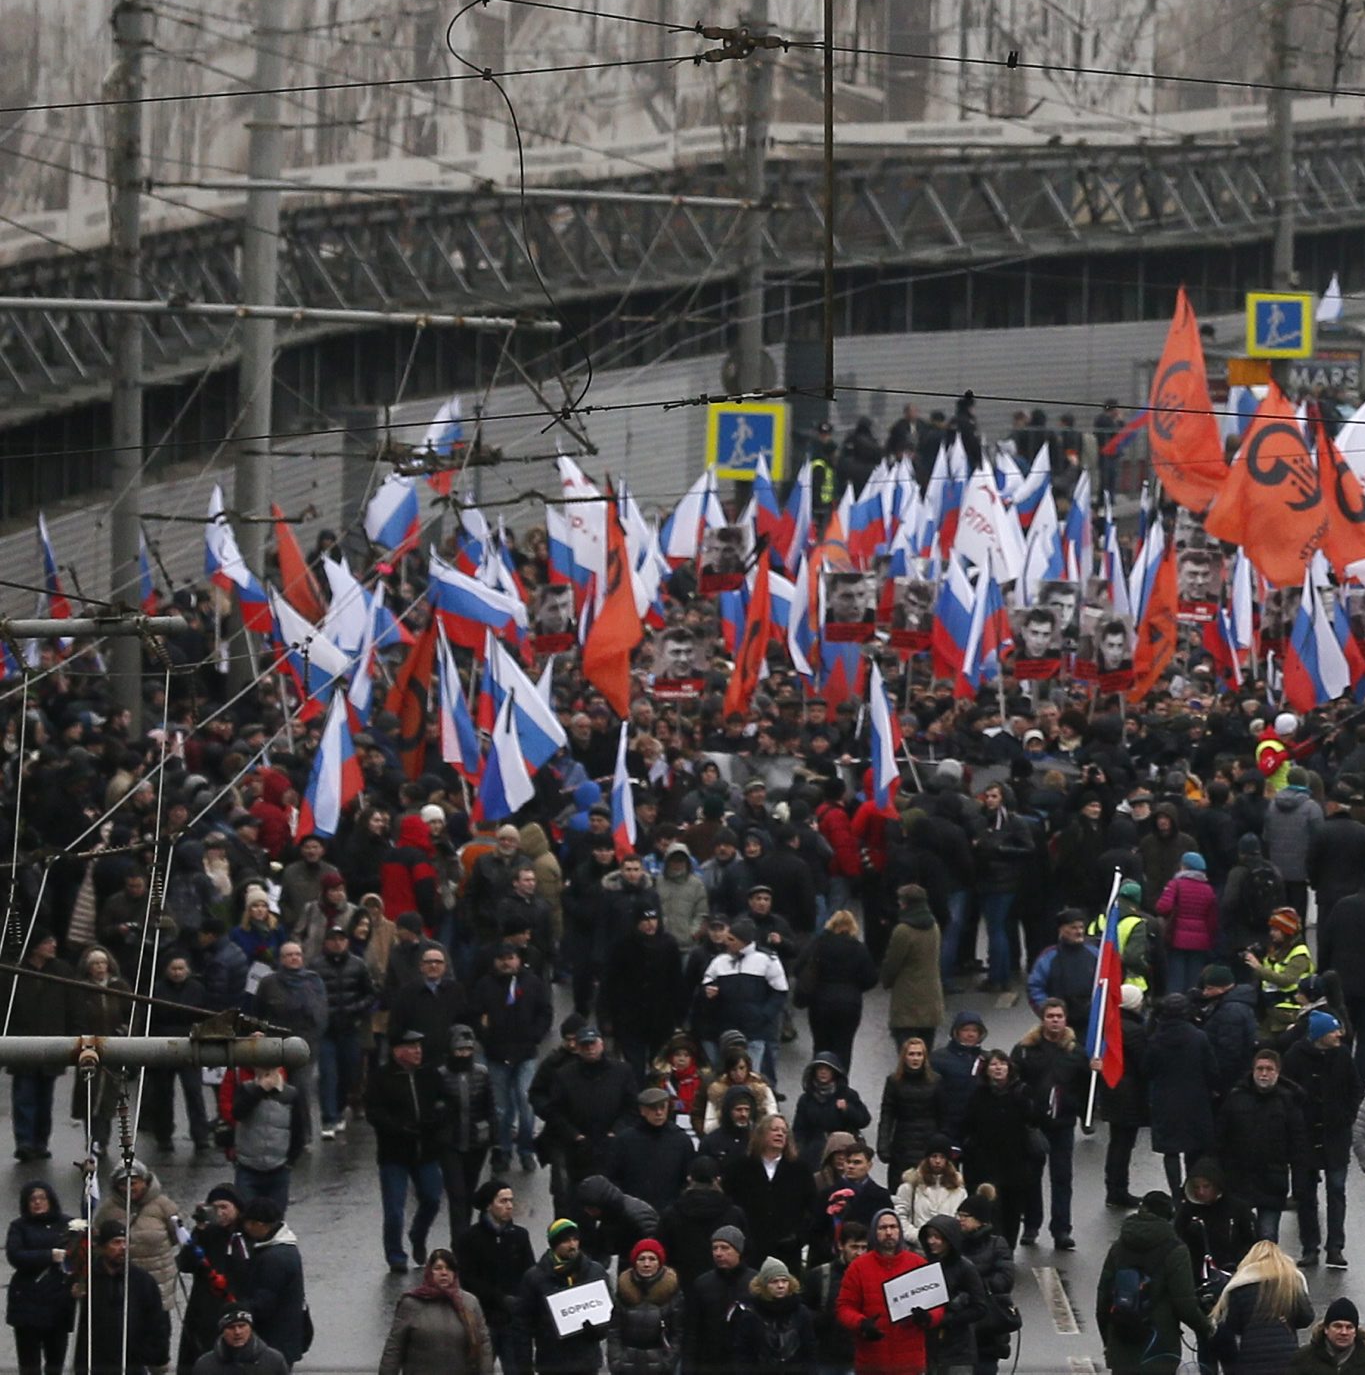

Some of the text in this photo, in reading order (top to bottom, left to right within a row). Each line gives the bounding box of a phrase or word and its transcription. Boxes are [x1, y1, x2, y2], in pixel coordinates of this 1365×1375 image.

[1289, 367, 1359, 389] MARS
[899, 1292, 910, 1301] НЕ
[911, 1282, 940, 1295] БОЮСЬ
[560, 1299, 605, 1318] БОРИСЬ
